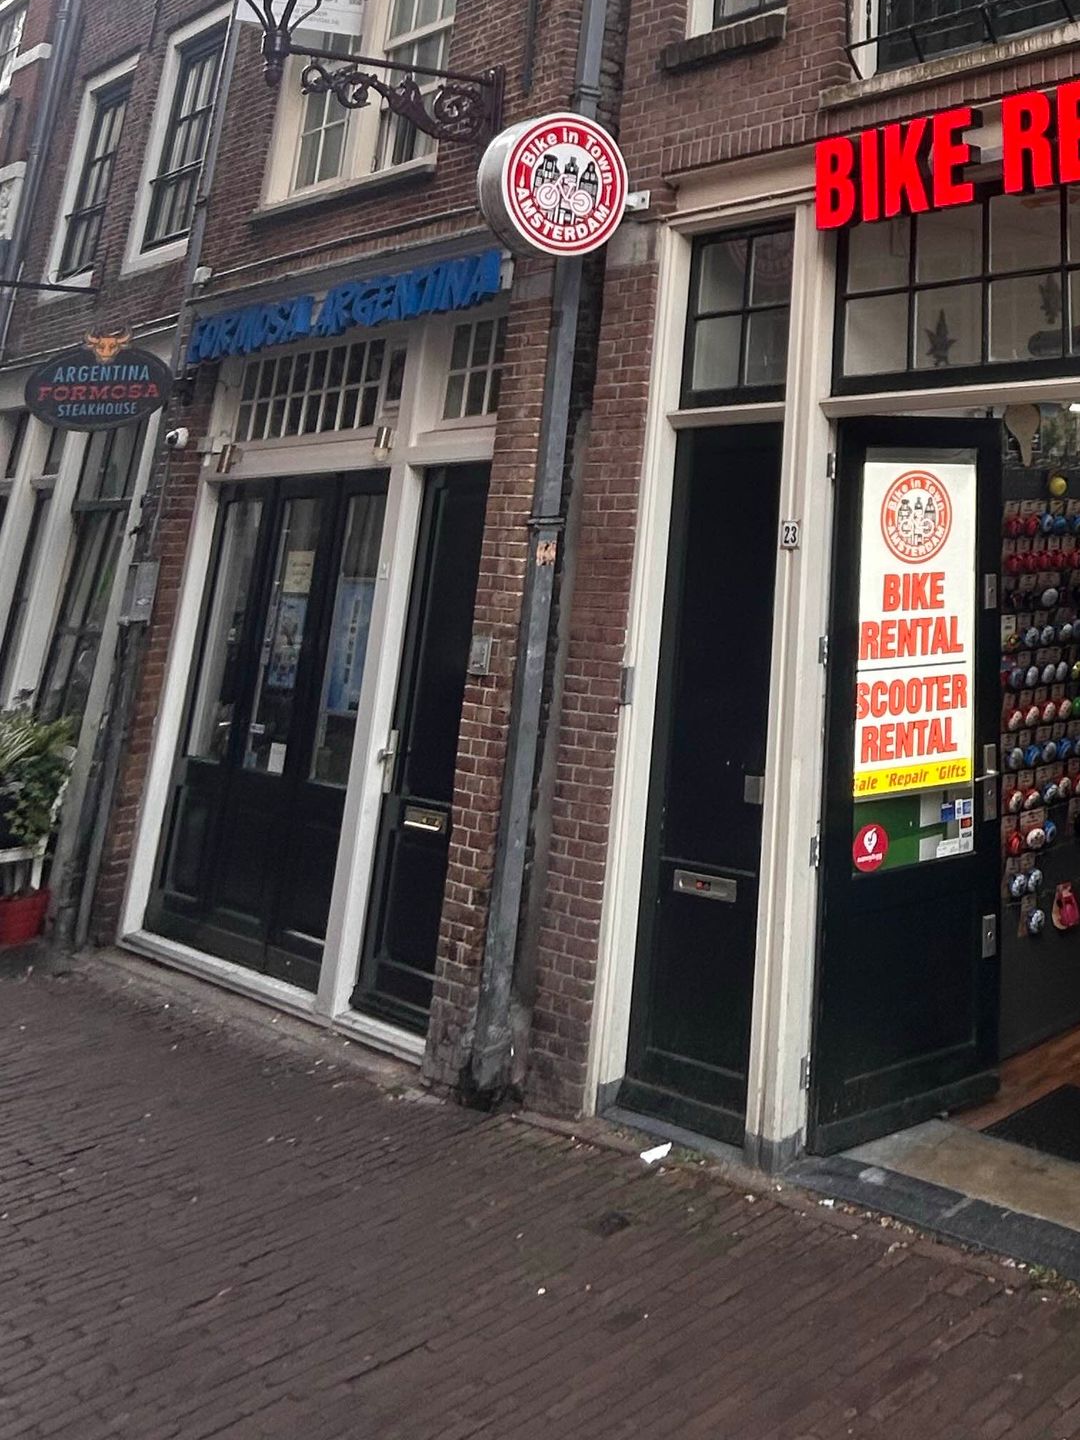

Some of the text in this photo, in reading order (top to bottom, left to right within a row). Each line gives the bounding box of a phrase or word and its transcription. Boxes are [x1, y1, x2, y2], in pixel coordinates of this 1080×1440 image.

[521, 128, 613, 184] Bike in Town
[816, 107, 974, 231] BIKE
[516, 187, 611, 241] AMSTERDAM
[310, 247, 502, 337] ARGENTINA
[37, 383, 159, 402] FORMOSA
[52, 365, 150, 383] ARGENTINA
[57, 402, 137, 417] STEAKHOUSE
[784, 526, 796, 543] 23
[887, 525, 945, 557] AMSTERDAM
[882, 572, 945, 612] BIKE
[859, 616, 964, 660] RENTAL
[856, 673, 968, 720] SCOOTER
[860, 717, 957, 763] RENTAL
